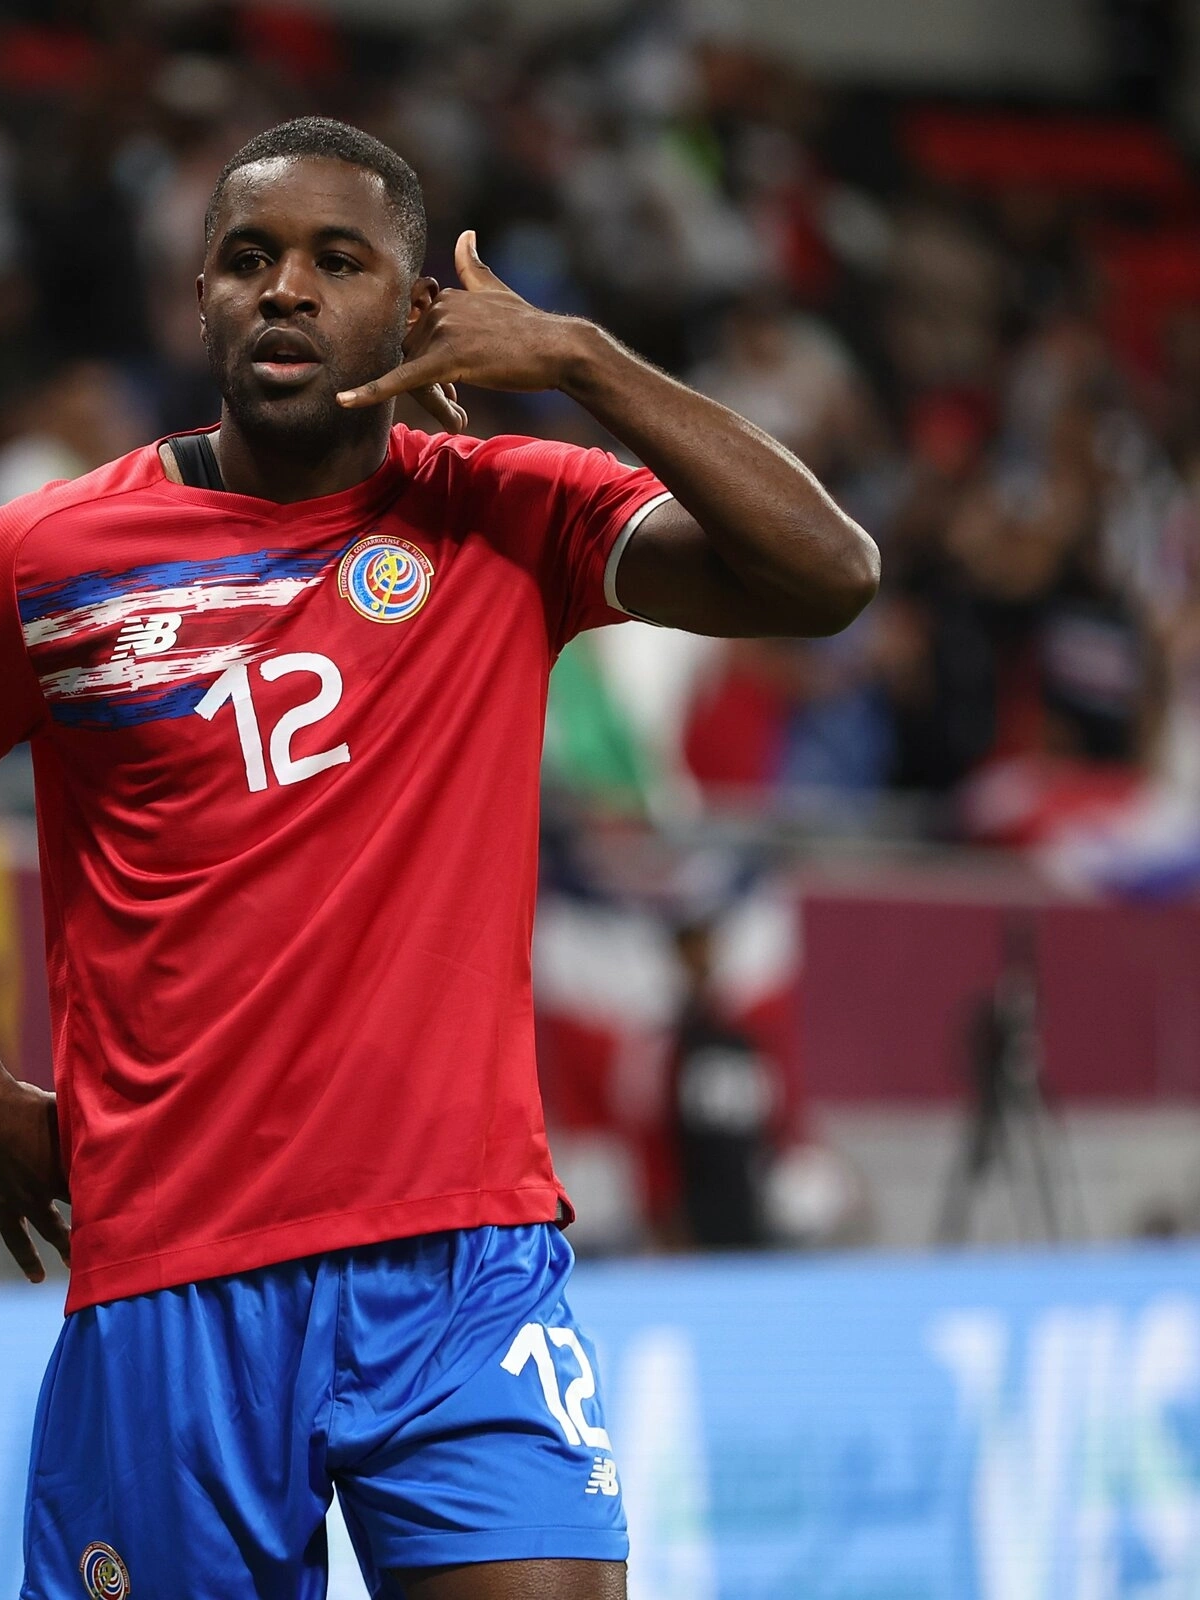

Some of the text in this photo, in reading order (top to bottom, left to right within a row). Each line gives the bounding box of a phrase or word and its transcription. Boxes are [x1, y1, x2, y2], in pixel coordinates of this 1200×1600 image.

[353, 537, 401, 554] COSTARRICENSE
[401, 542, 411, 551] DE
[411, 548, 430, 570] FUTBOL
[193, 651, 351, 793] 12
[499, 1322, 613, 1451] 12
